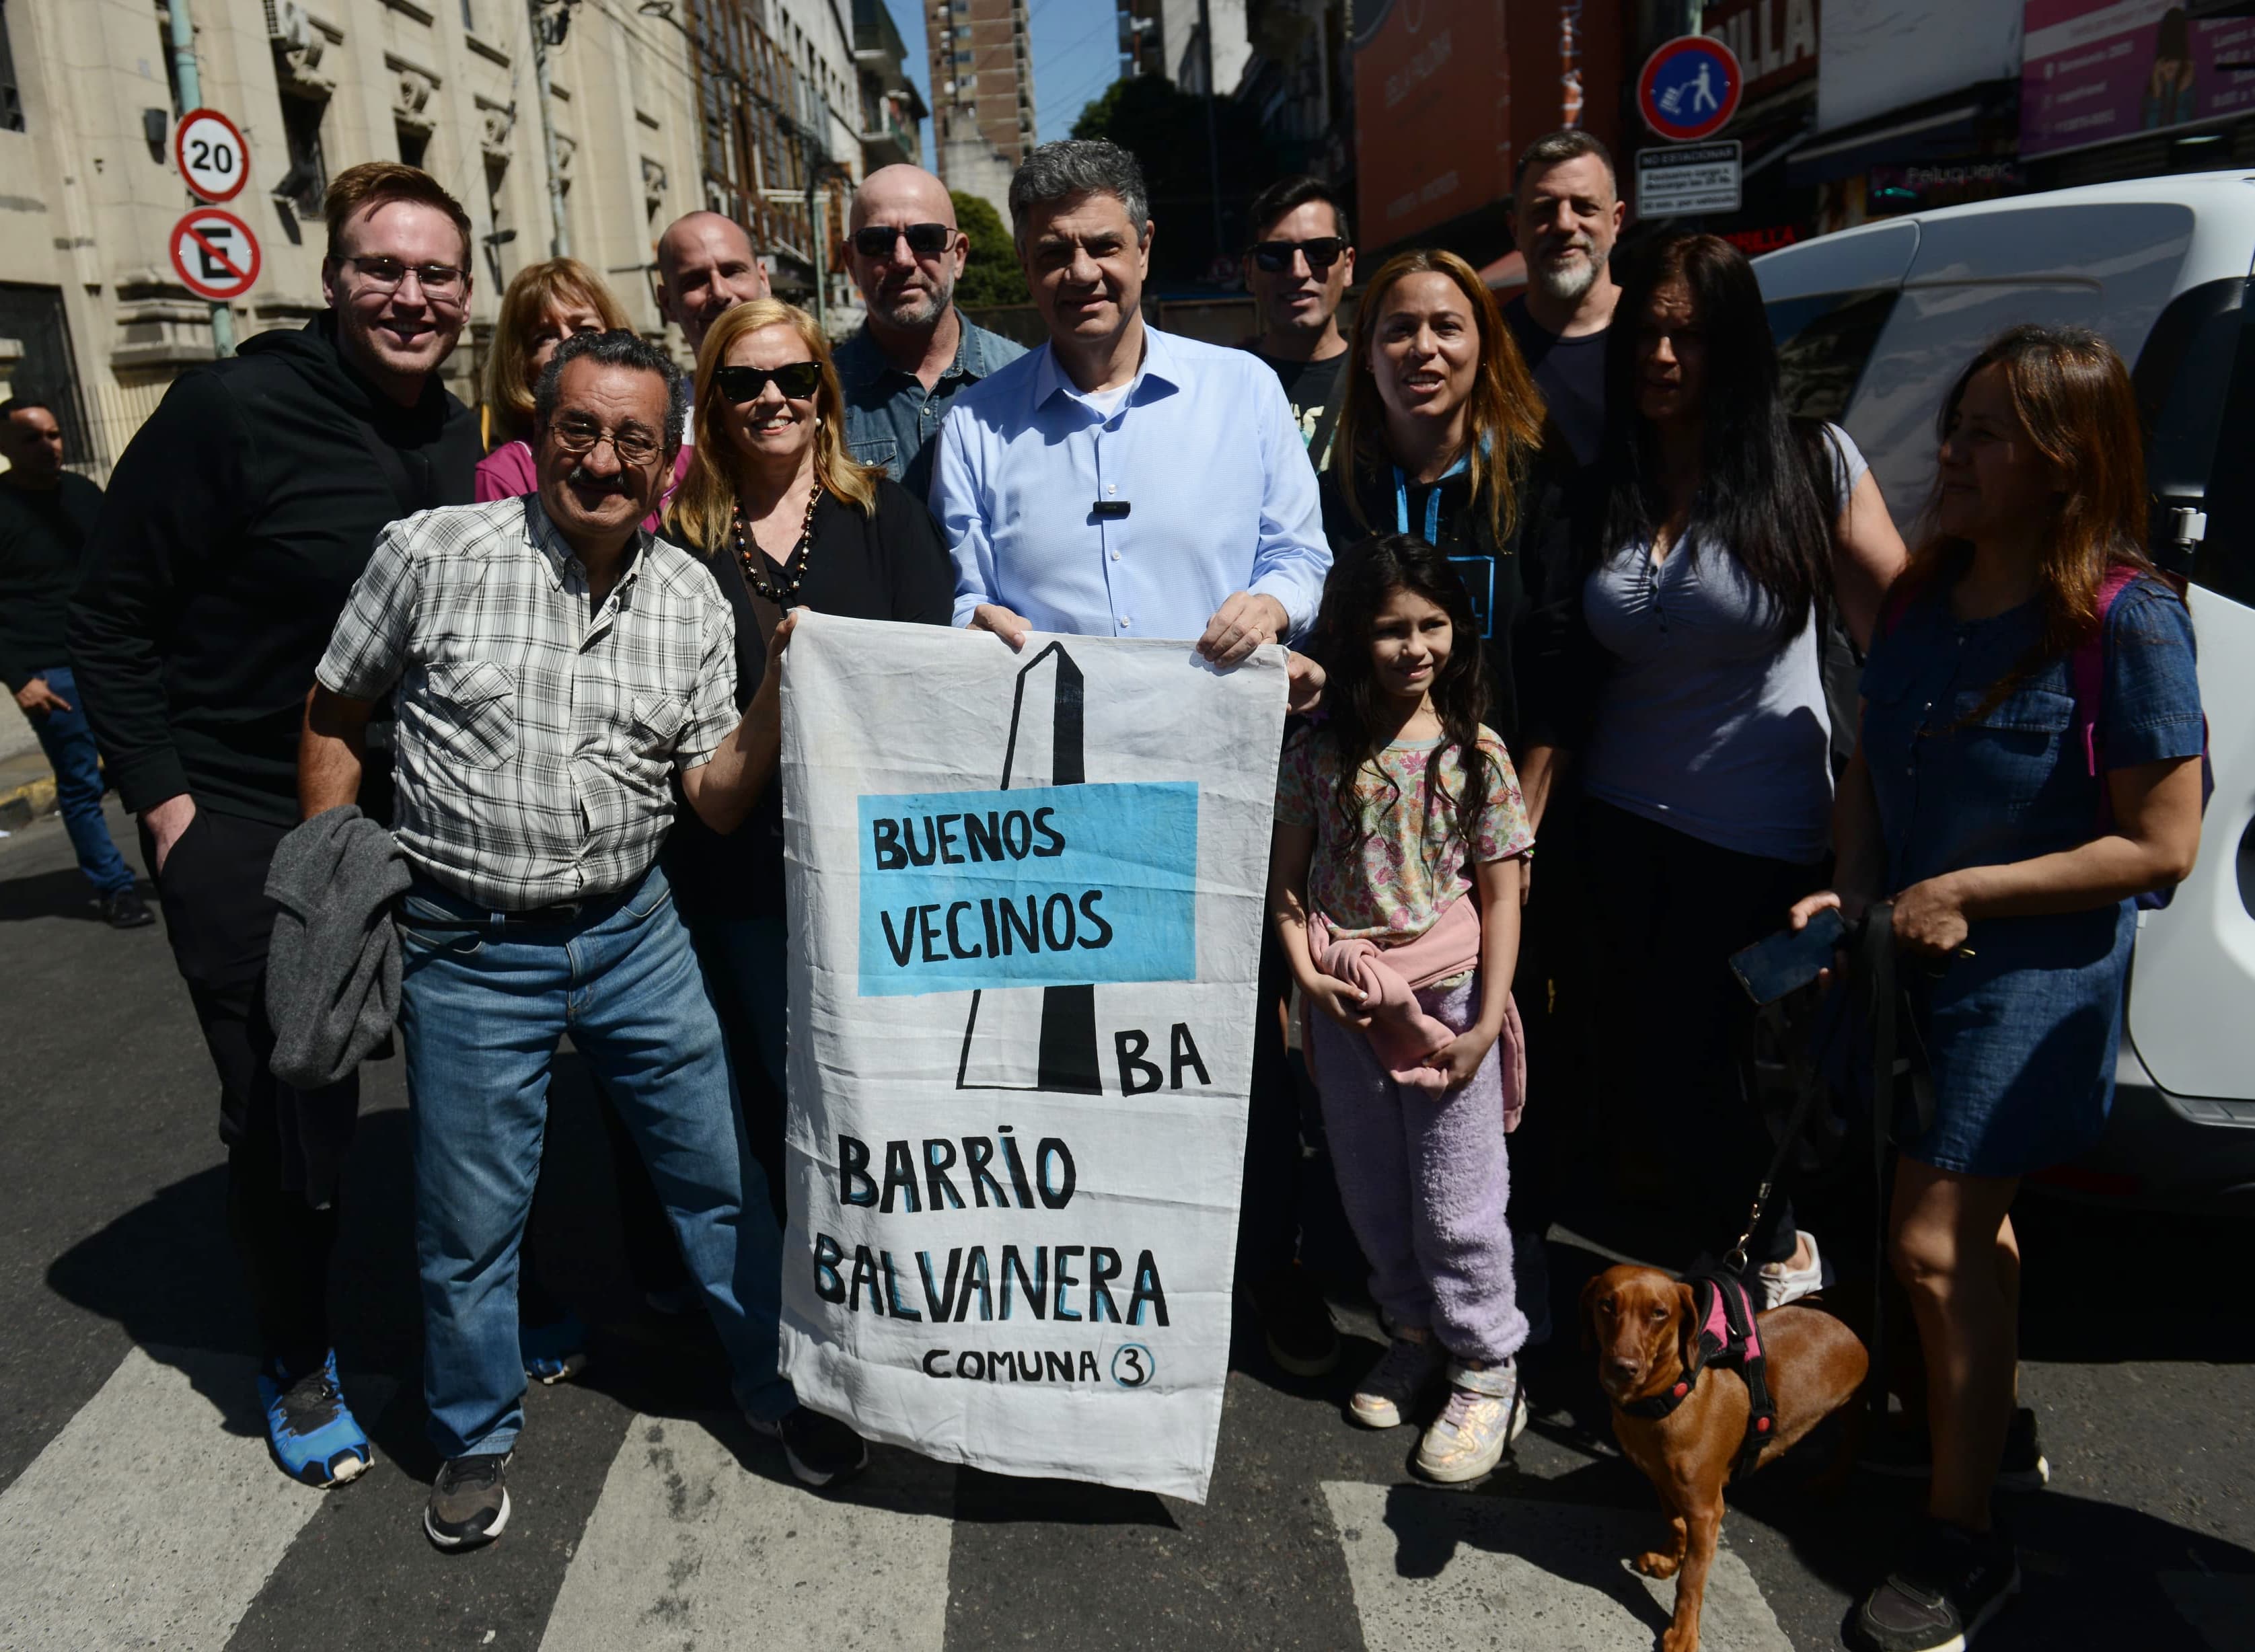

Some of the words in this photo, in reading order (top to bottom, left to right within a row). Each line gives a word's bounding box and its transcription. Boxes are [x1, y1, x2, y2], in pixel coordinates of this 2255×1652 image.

[192, 140, 233, 174] 20
[196, 227, 237, 278] E
[873, 806, 1066, 870] BUENOS
[881, 889, 1113, 967] VECINOS
[1114, 1022, 1212, 1097] BA
[813, 1232, 1170, 1326] BALVANERA
[922, 1348, 1101, 1383] COMUNA
[1117, 1346, 1148, 1386] 3
